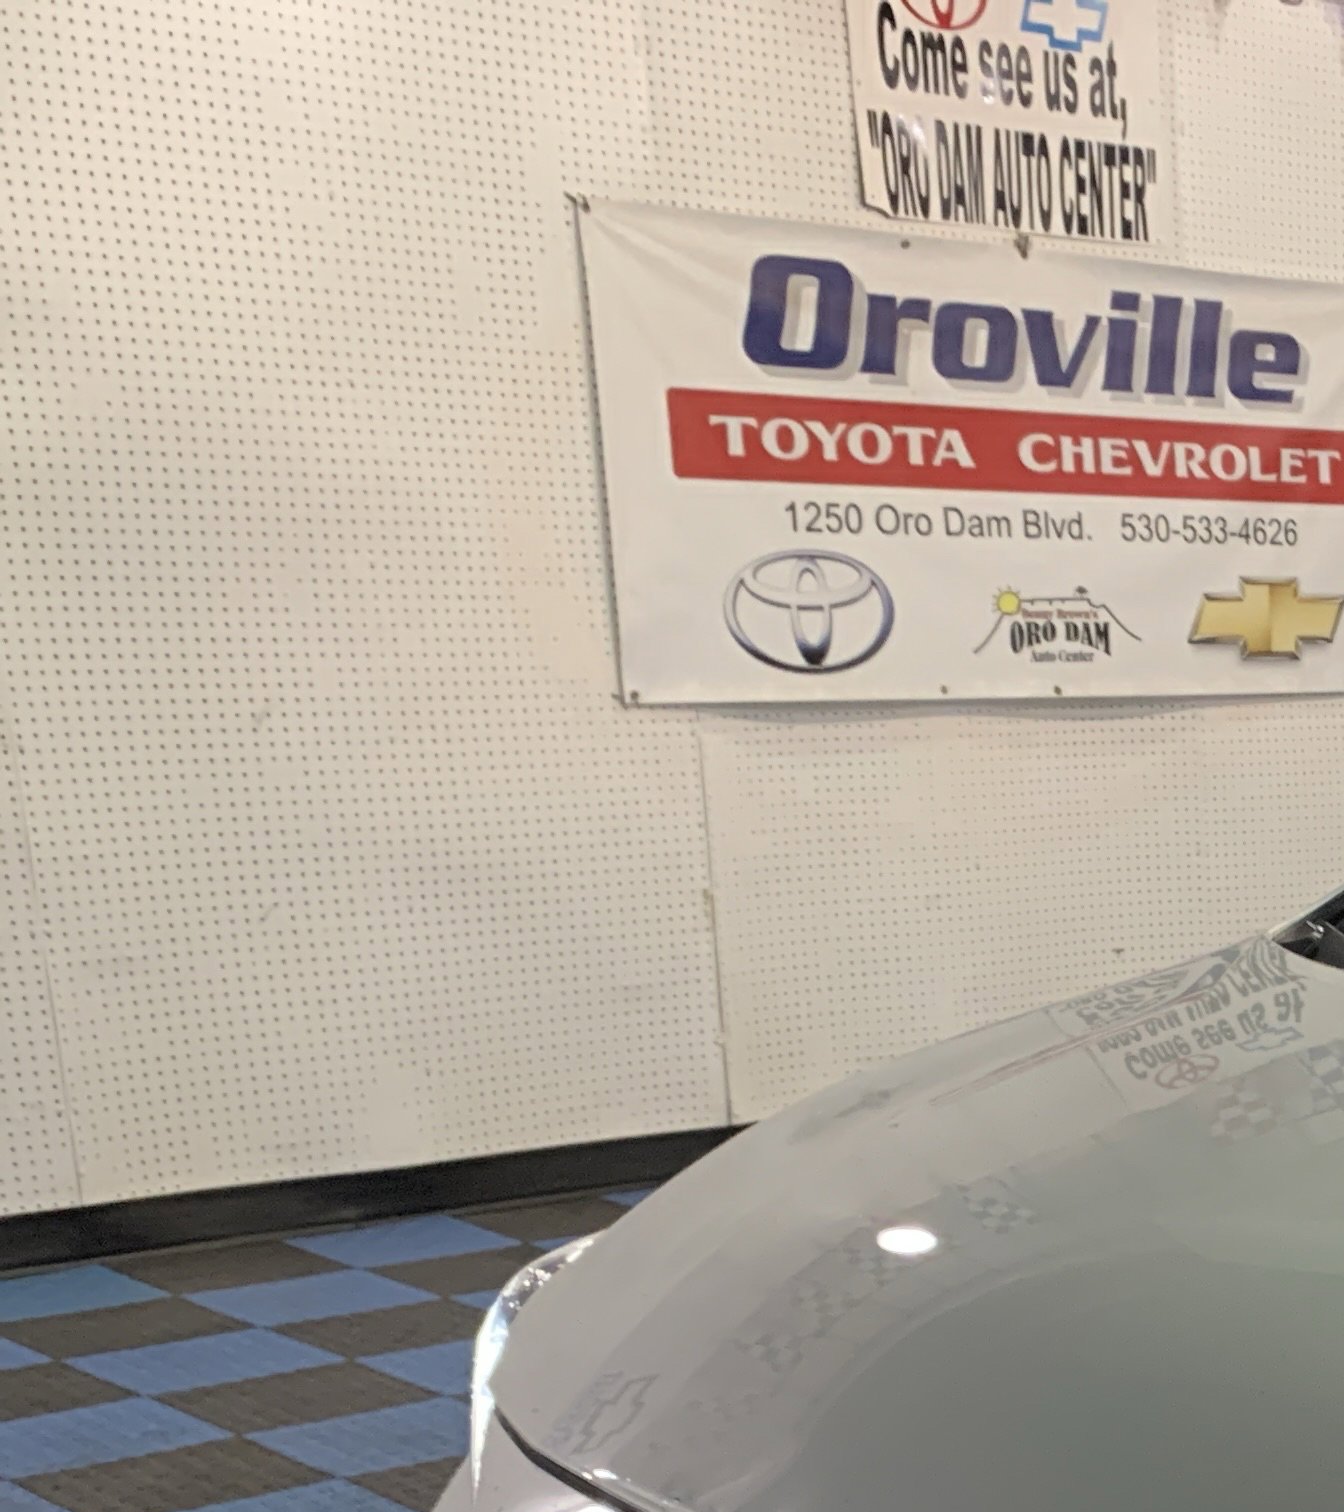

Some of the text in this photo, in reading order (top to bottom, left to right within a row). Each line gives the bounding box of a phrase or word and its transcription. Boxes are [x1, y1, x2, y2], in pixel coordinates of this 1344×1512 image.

[876, 1, 1128, 139] Come see us at,
[935, 119, 987, 226] DAM
[993, 127, 1052, 232] AUTO
[741, 253, 1304, 404] Oroville
[708, 414, 1343, 486] TOYOTA CHEVROLET
[784, 501, 1299, 546] 1250 Oro Dam Blvd. 530-533-4626
[1010, 620, 1112, 657] ORO DAM
[1030, 650, 1095, 663] Auto Center
